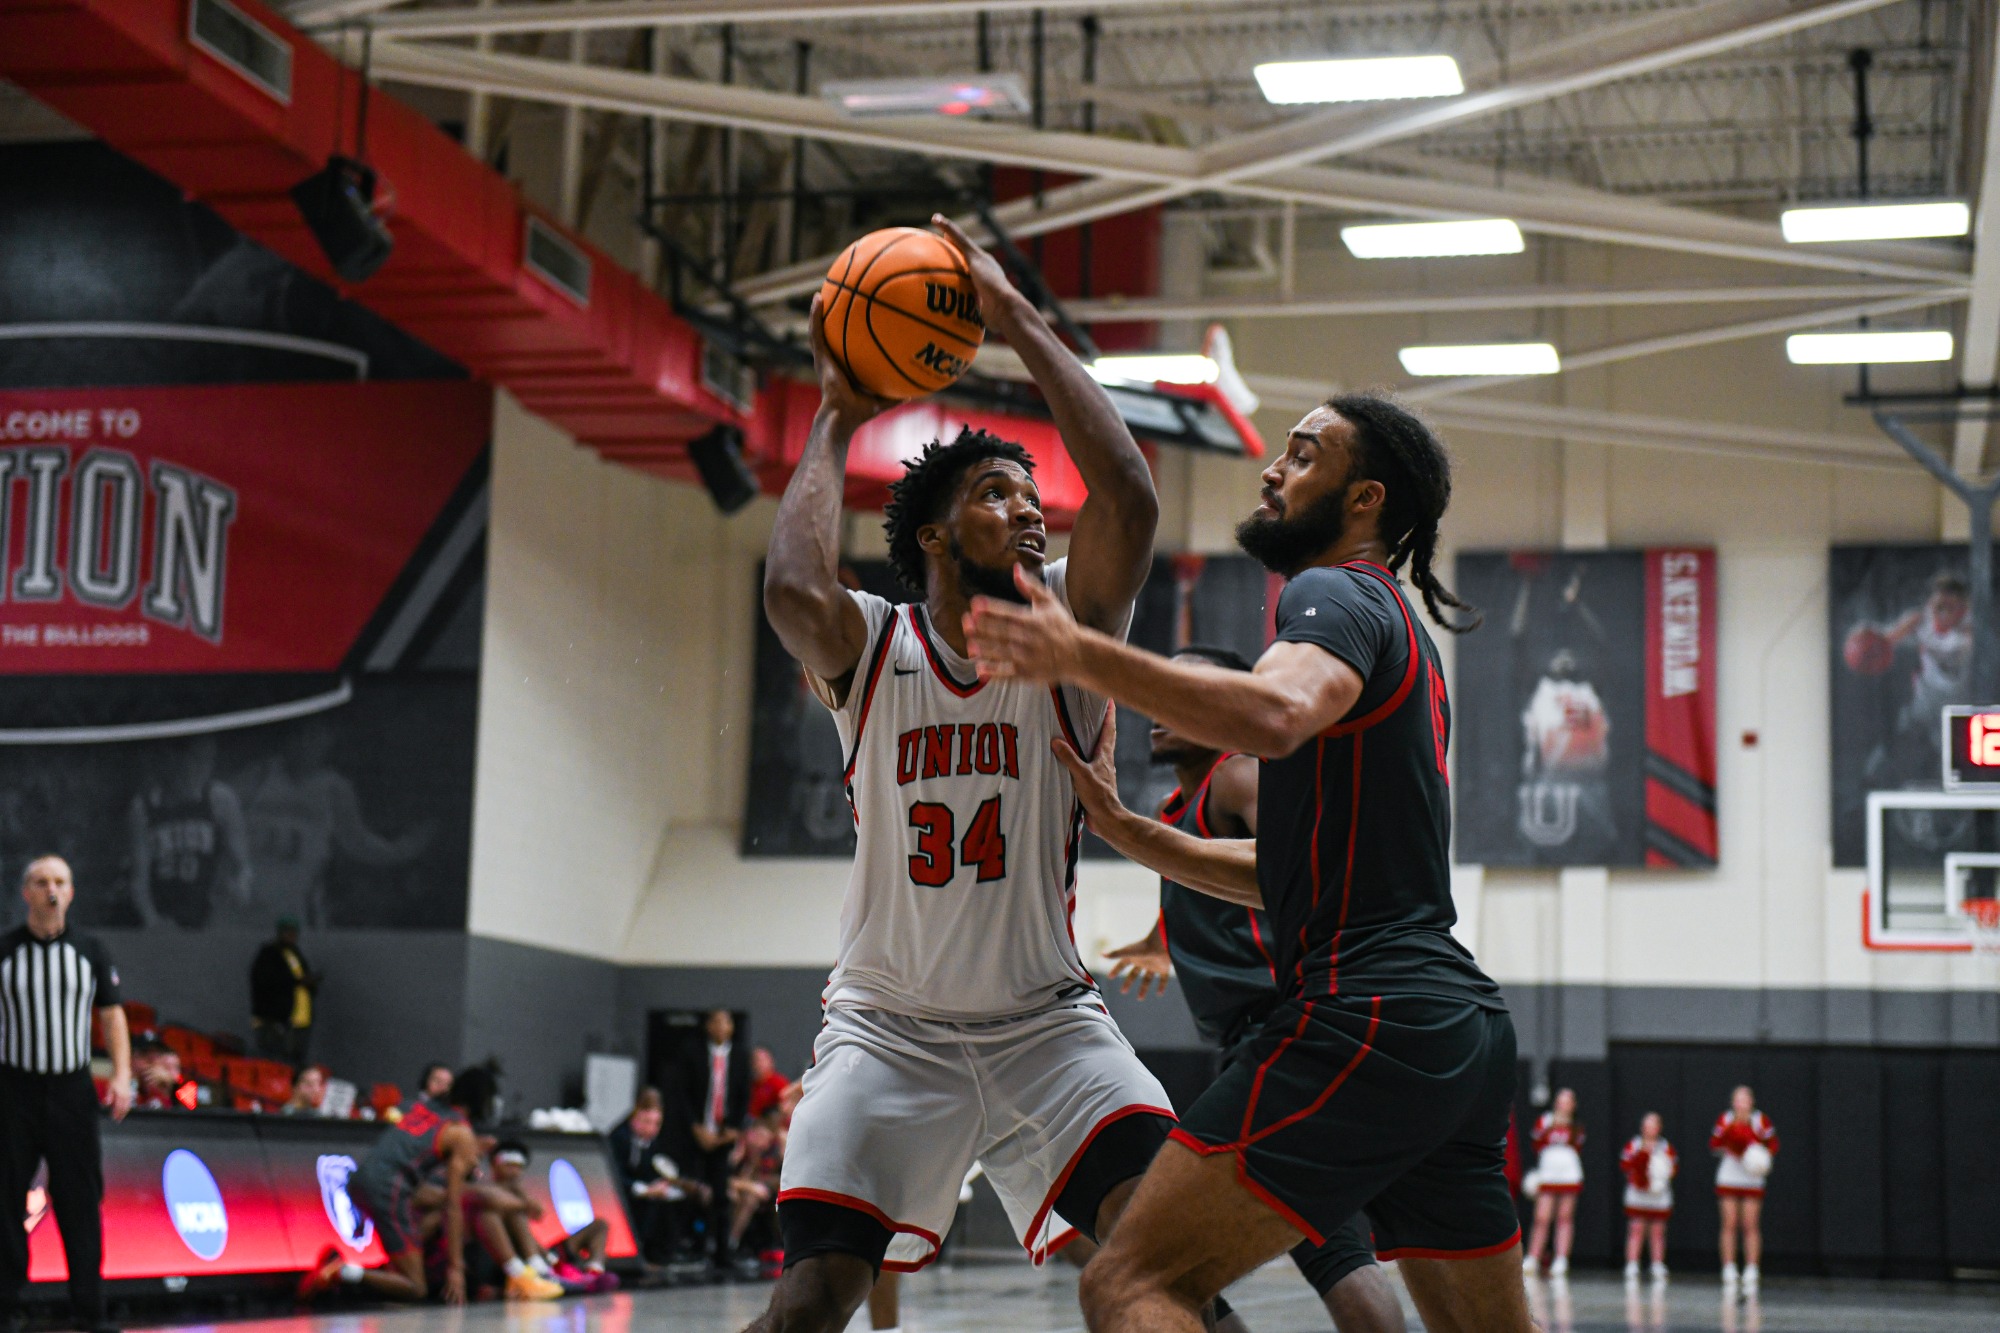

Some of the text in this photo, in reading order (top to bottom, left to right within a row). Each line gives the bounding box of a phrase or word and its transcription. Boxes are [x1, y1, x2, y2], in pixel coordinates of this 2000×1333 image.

[0, 408, 140, 438] COME TO
[3, 624, 38, 646] THE
[896, 722, 1020, 786] UNION
[908, 793, 1006, 888] 34
